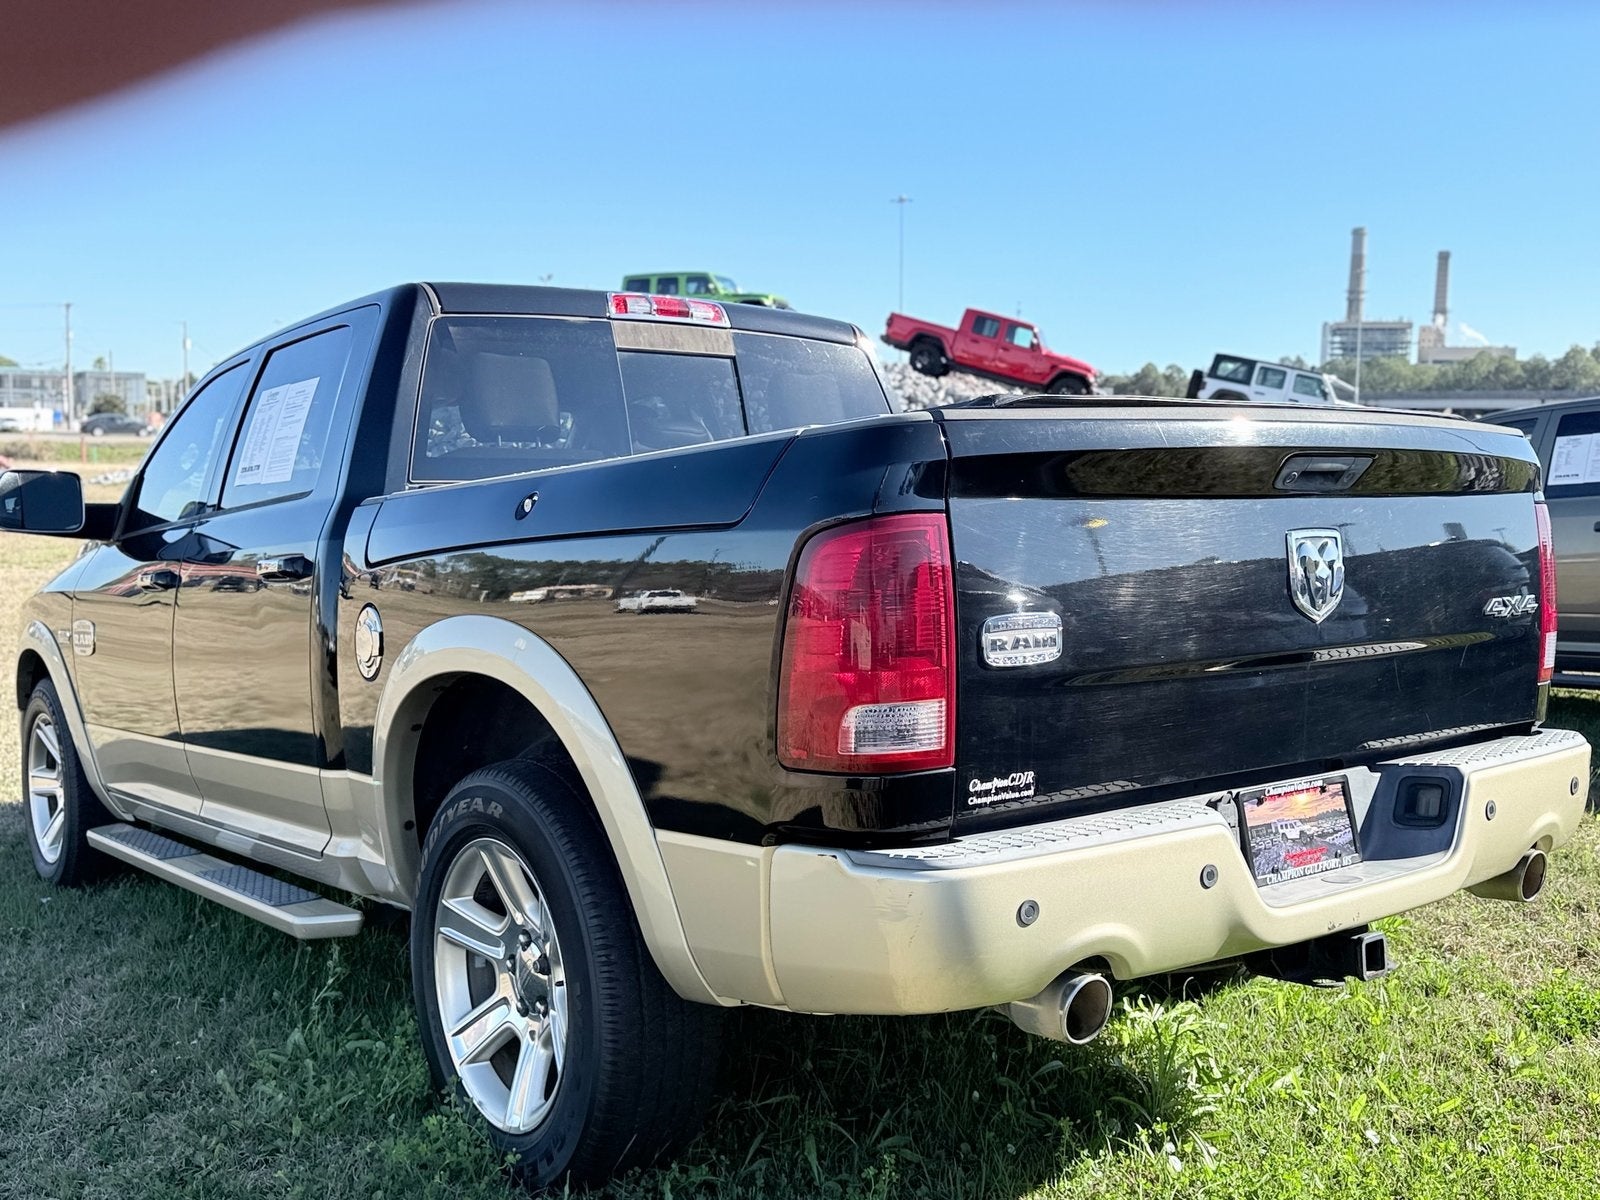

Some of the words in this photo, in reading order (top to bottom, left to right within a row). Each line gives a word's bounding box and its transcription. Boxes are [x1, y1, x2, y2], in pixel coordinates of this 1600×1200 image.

[988, 633, 1057, 652] RAM
[416, 797, 504, 898] ODYEAR
[1266, 868, 1304, 884] CHAMPION
